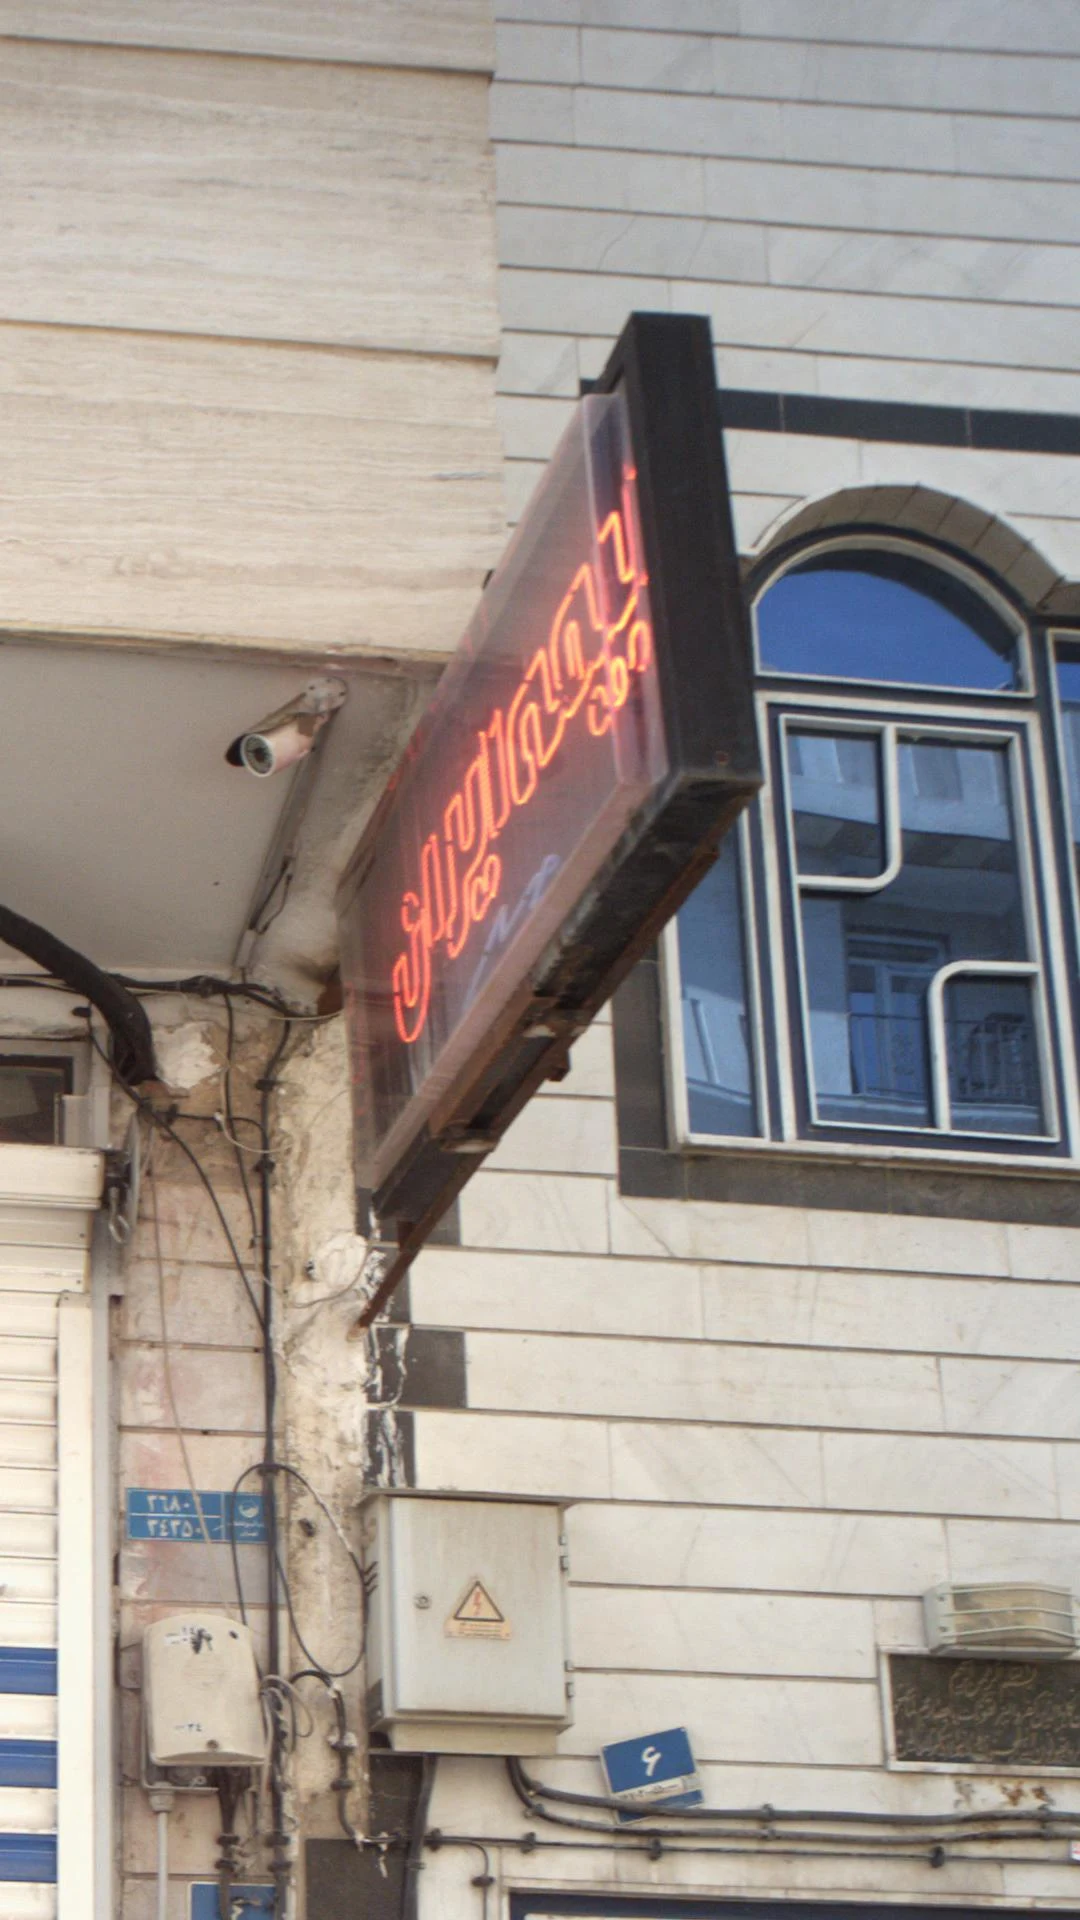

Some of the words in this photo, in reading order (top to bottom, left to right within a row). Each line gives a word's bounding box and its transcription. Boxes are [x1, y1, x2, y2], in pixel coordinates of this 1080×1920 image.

[504, 464, 652, 805] بیمه
[393, 708, 512, 1042] ایران
[641, 1746, 662, 1777] ۶
